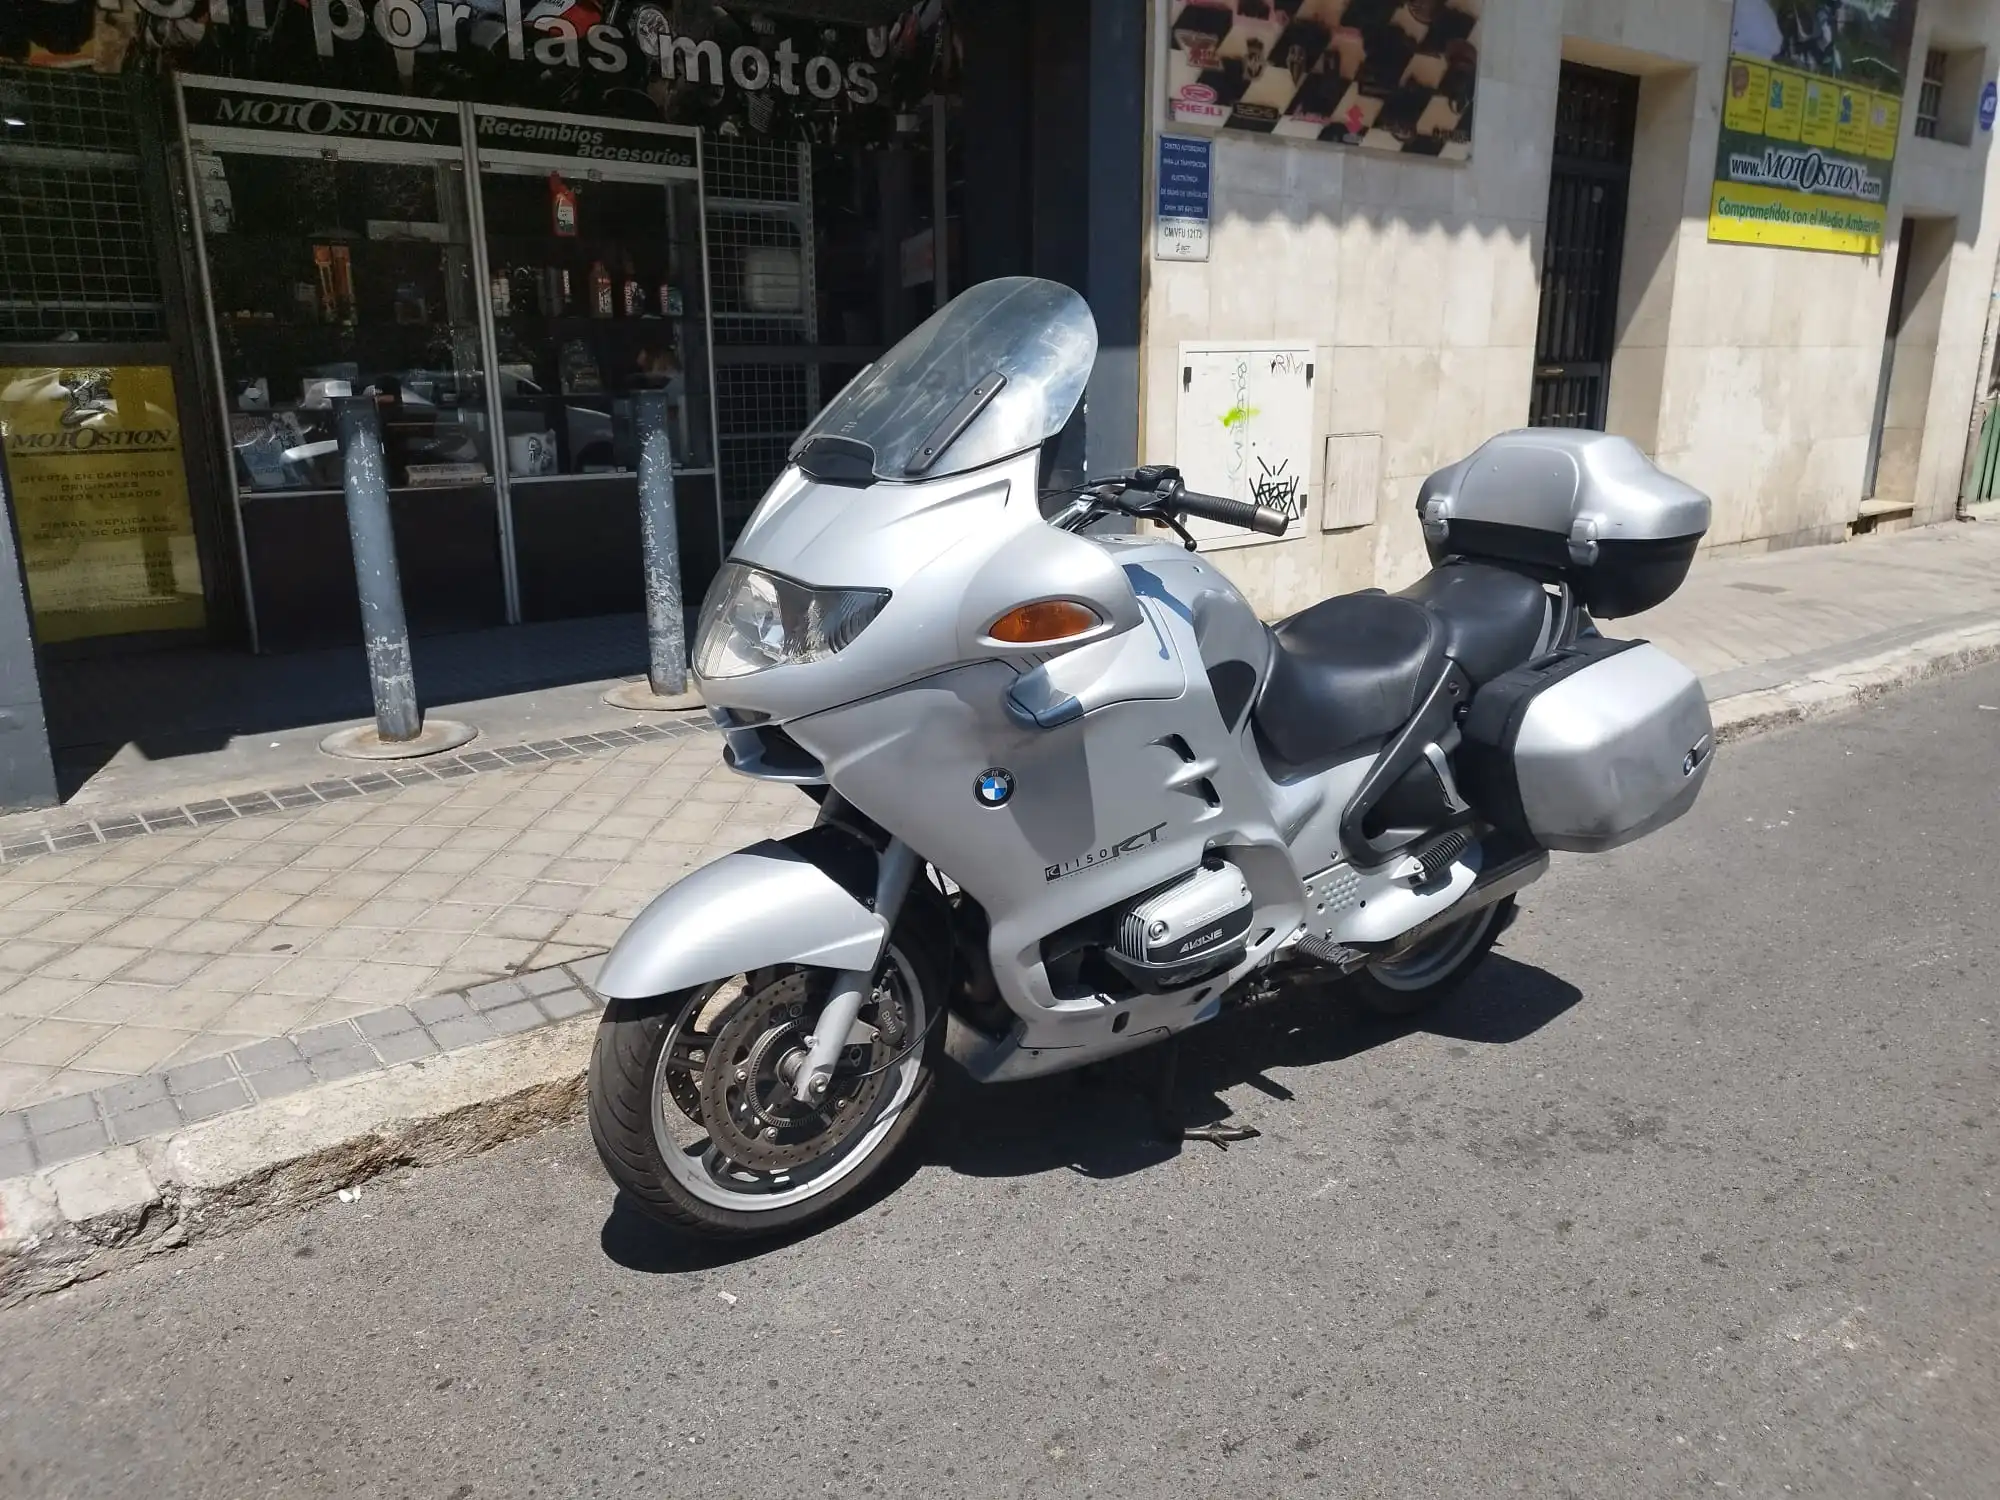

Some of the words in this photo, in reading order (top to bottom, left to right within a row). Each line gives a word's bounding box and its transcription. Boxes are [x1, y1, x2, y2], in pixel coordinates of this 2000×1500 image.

[311, 0, 472, 57] por
[504, 0, 629, 73] las
[659, 32, 879, 104] motos
[216, 97, 440, 138] MOTOSTION
[1171, 102, 1222, 116] RIEJU
[479, 117, 604, 145] Recambios
[576, 142, 692, 167] accesorios
[1718, 198, 1790, 223] Comprometidos
[1791, 211, 1808, 224] con
[1809, 211, 1818, 225] el
[1819, 211, 1844, 229] Medio
[1844, 214, 1881, 234] Ambiente
[12, 427, 171, 449] MOTOSTION
[979, 770, 1011, 784] BMW
